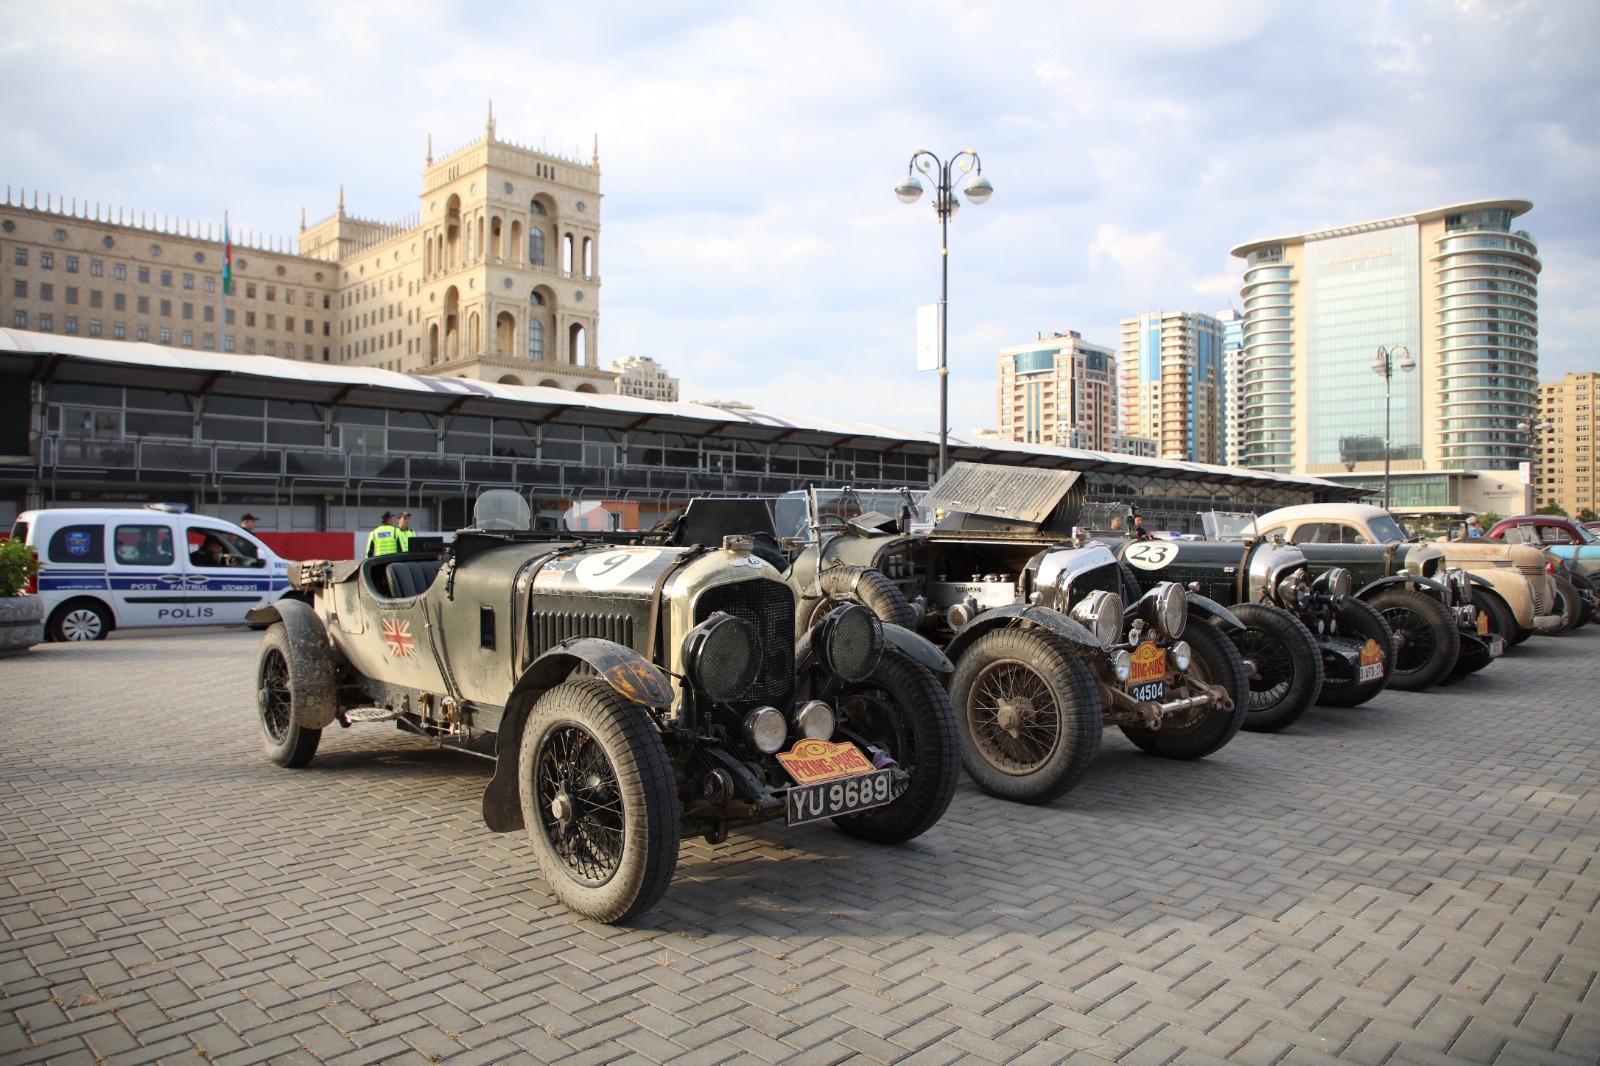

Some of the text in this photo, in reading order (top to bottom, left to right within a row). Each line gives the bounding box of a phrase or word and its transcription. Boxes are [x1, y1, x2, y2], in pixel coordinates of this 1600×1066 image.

[1130, 545, 1168, 564] 23
[592, 554, 632, 577] 9
[130, 583, 158, 591] POST
[170, 583, 210, 591] PATRUL
[158, 606, 214, 619] POLİS
[1133, 683, 1163, 702] 34504
[785, 757, 835, 779] PEKING
[830, 747, 867, 771] PARIS
[792, 775, 888, 820] YU 9689
